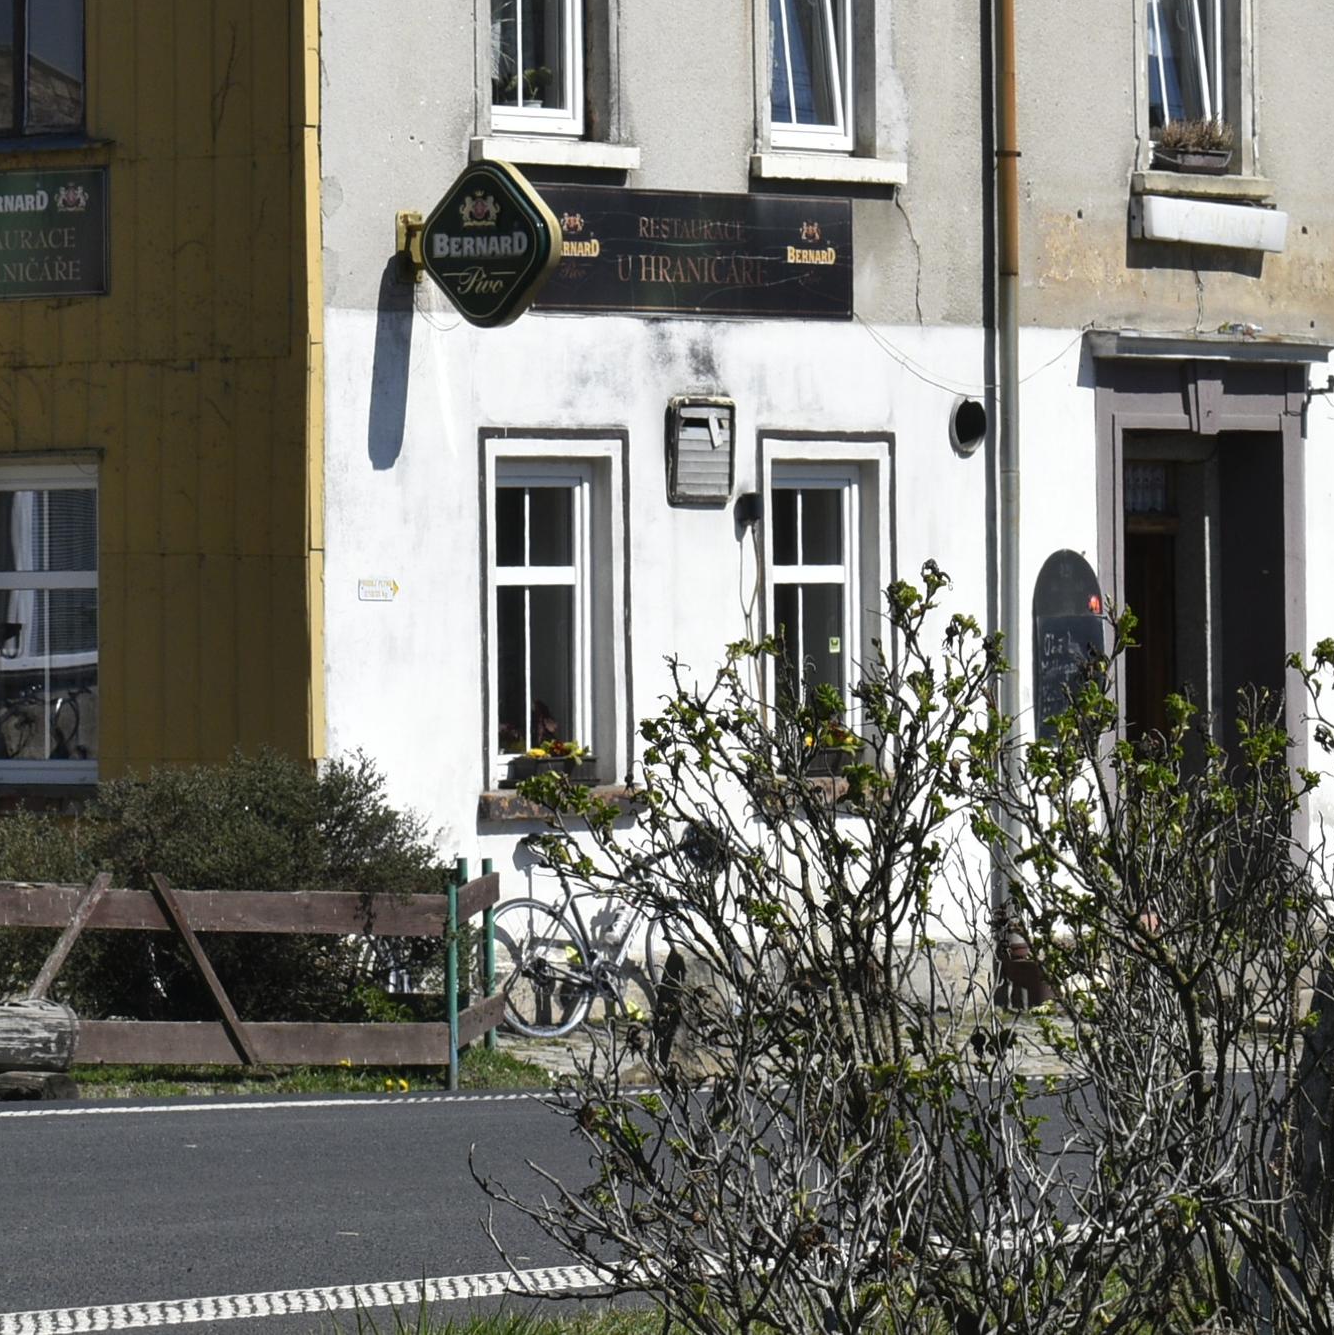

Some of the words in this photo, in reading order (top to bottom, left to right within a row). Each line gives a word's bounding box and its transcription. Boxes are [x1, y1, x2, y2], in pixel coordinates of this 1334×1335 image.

[639, 216, 746, 243] RESTAURACE
[433, 231, 528, 259] BERNARD
[787, 246, 836, 265] BERNARD
[457, 266, 504, 295] Pivo
[618, 254, 633, 282] U
